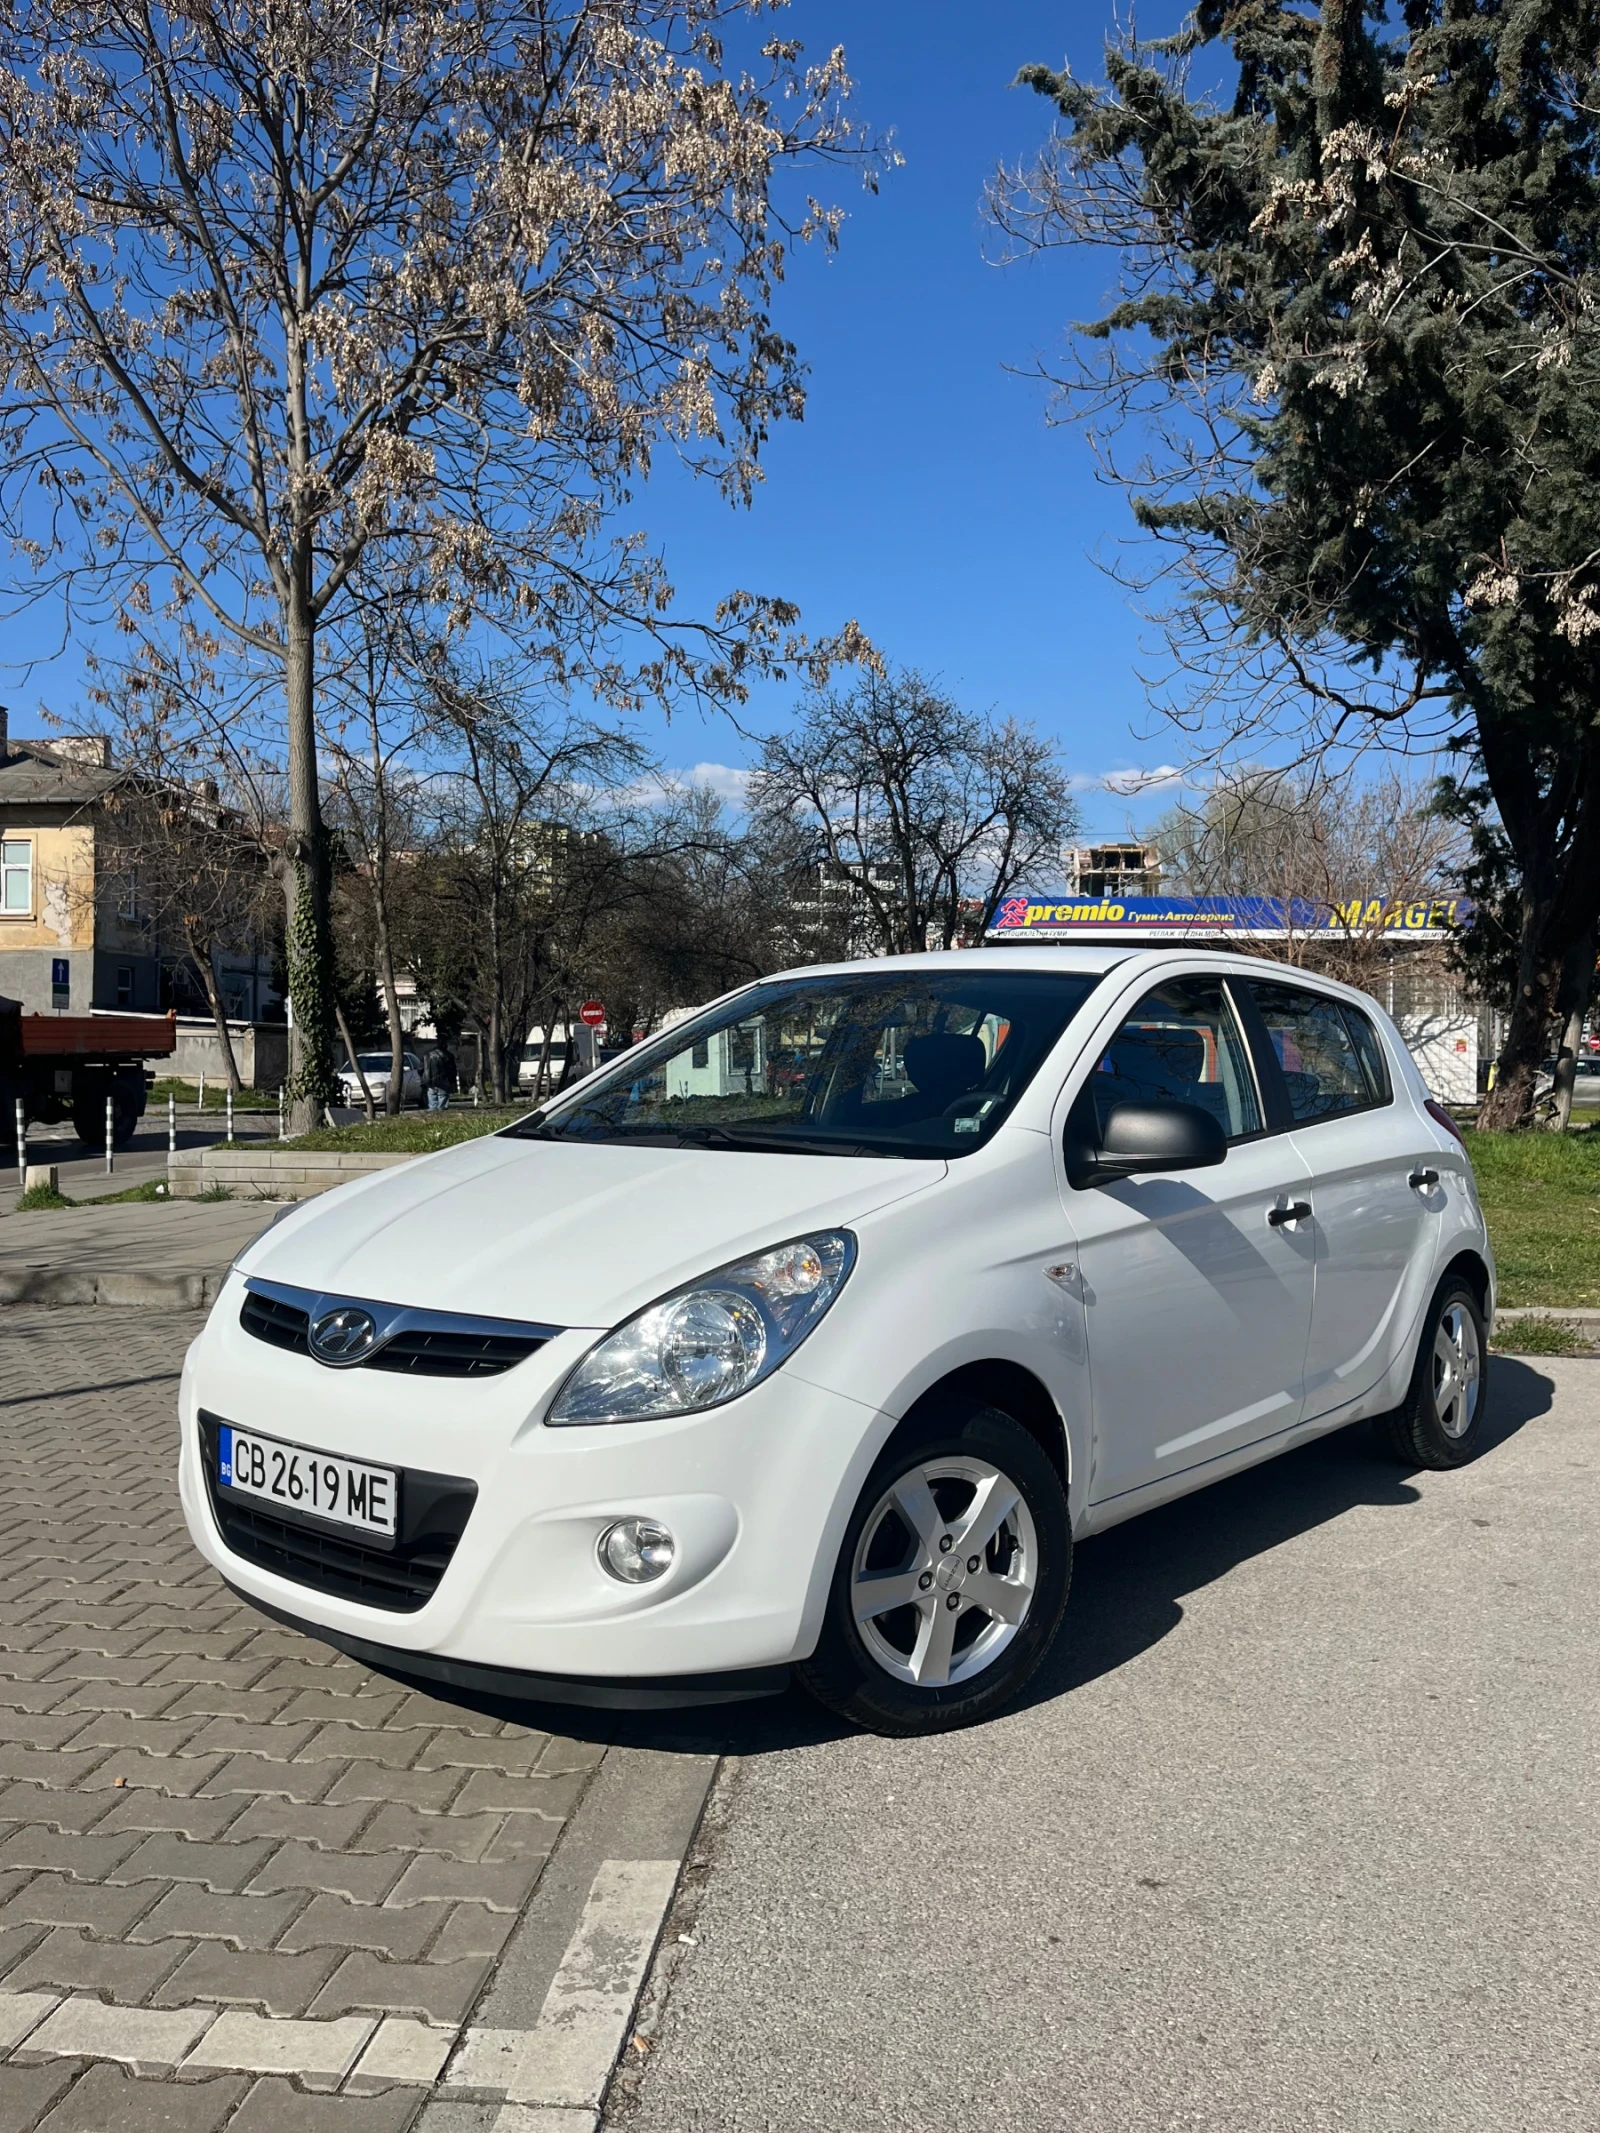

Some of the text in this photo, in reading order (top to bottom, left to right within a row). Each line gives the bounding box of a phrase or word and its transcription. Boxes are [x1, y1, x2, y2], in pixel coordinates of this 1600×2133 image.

[1023, 899, 1125, 927] premio
[221, 1461, 232, 1477] BG
[235, 1439, 389, 1526] CB 2619 ME
